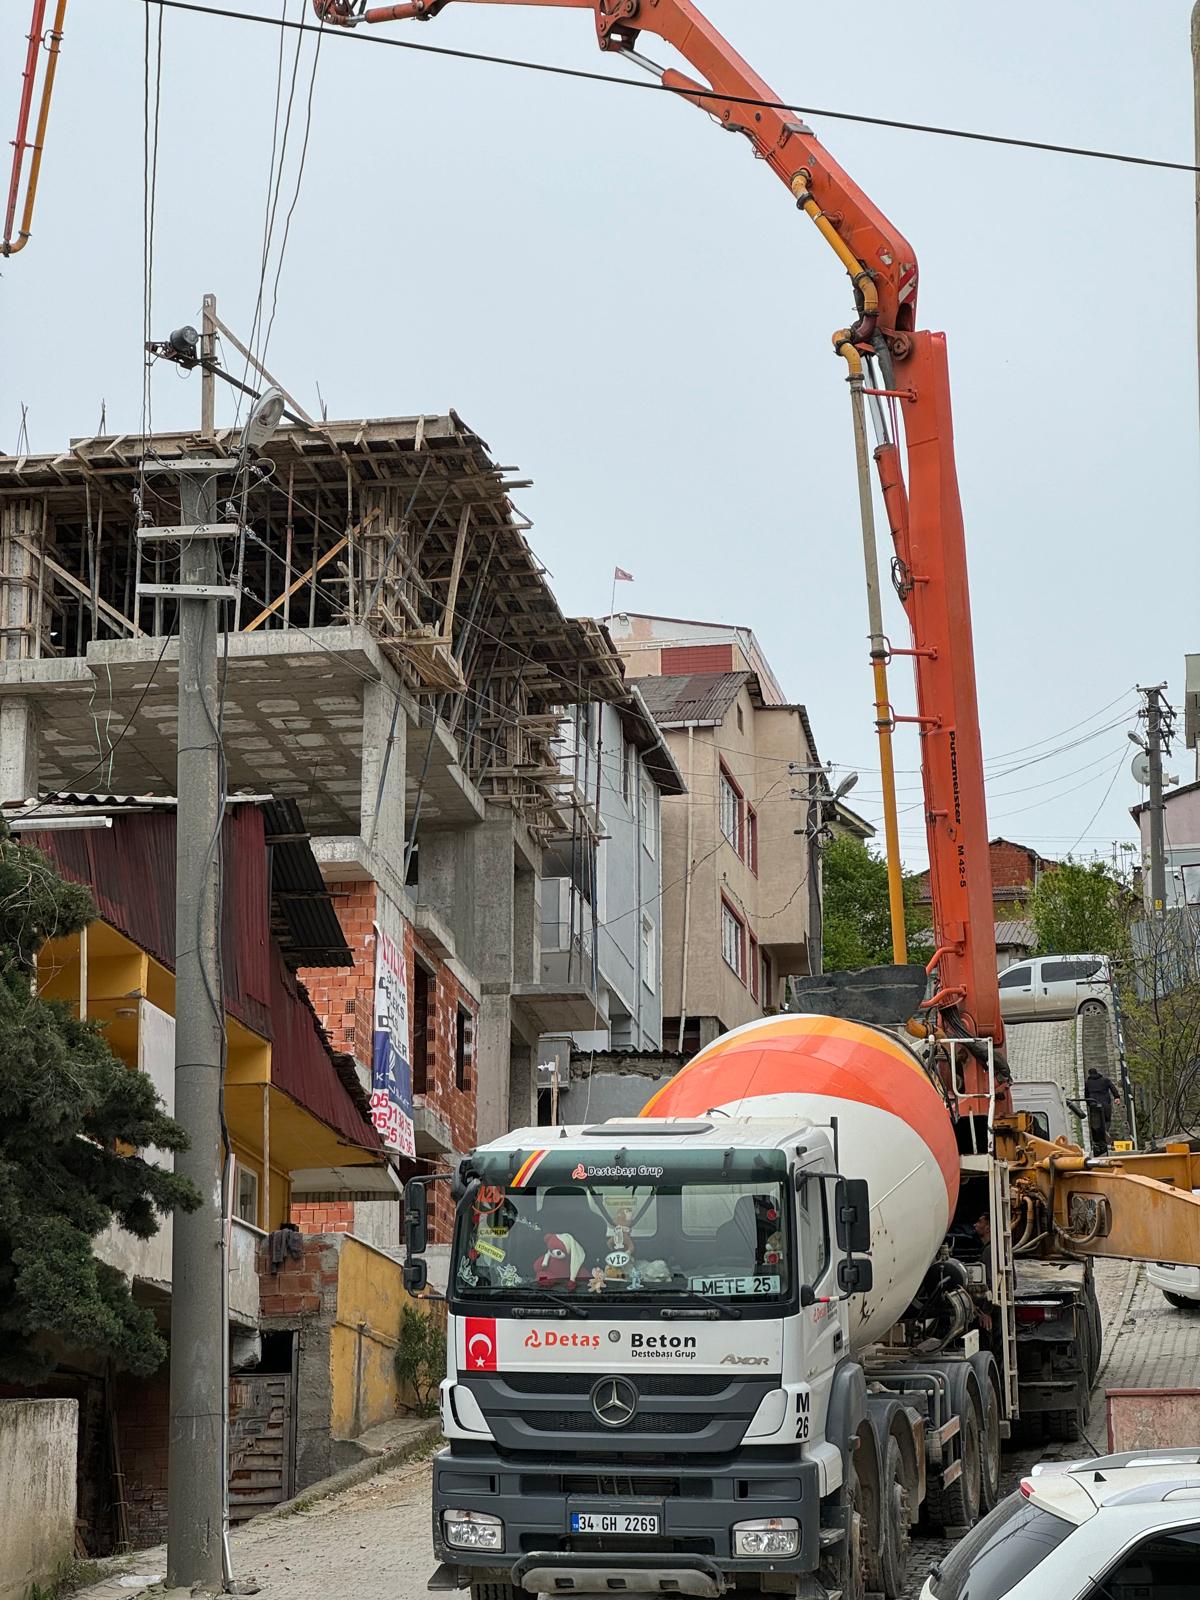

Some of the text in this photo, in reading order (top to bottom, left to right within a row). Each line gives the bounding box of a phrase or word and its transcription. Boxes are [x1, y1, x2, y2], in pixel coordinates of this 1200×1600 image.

[957, 845, 964, 856] M
[588, 1165, 664, 1178] Destebaşı Grup
[701, 1277, 771, 1295] METE 25
[544, 1331, 697, 1350] Detaş Beton
[631, 1349, 697, 1360] Destebaşı Grup
[795, 1391, 810, 1414] M
[795, 1416, 809, 1439] 26
[579, 1516, 594, 1531] 34
[601, 1516, 617, 1532] GH
[624, 1517, 656, 1532] 2269
